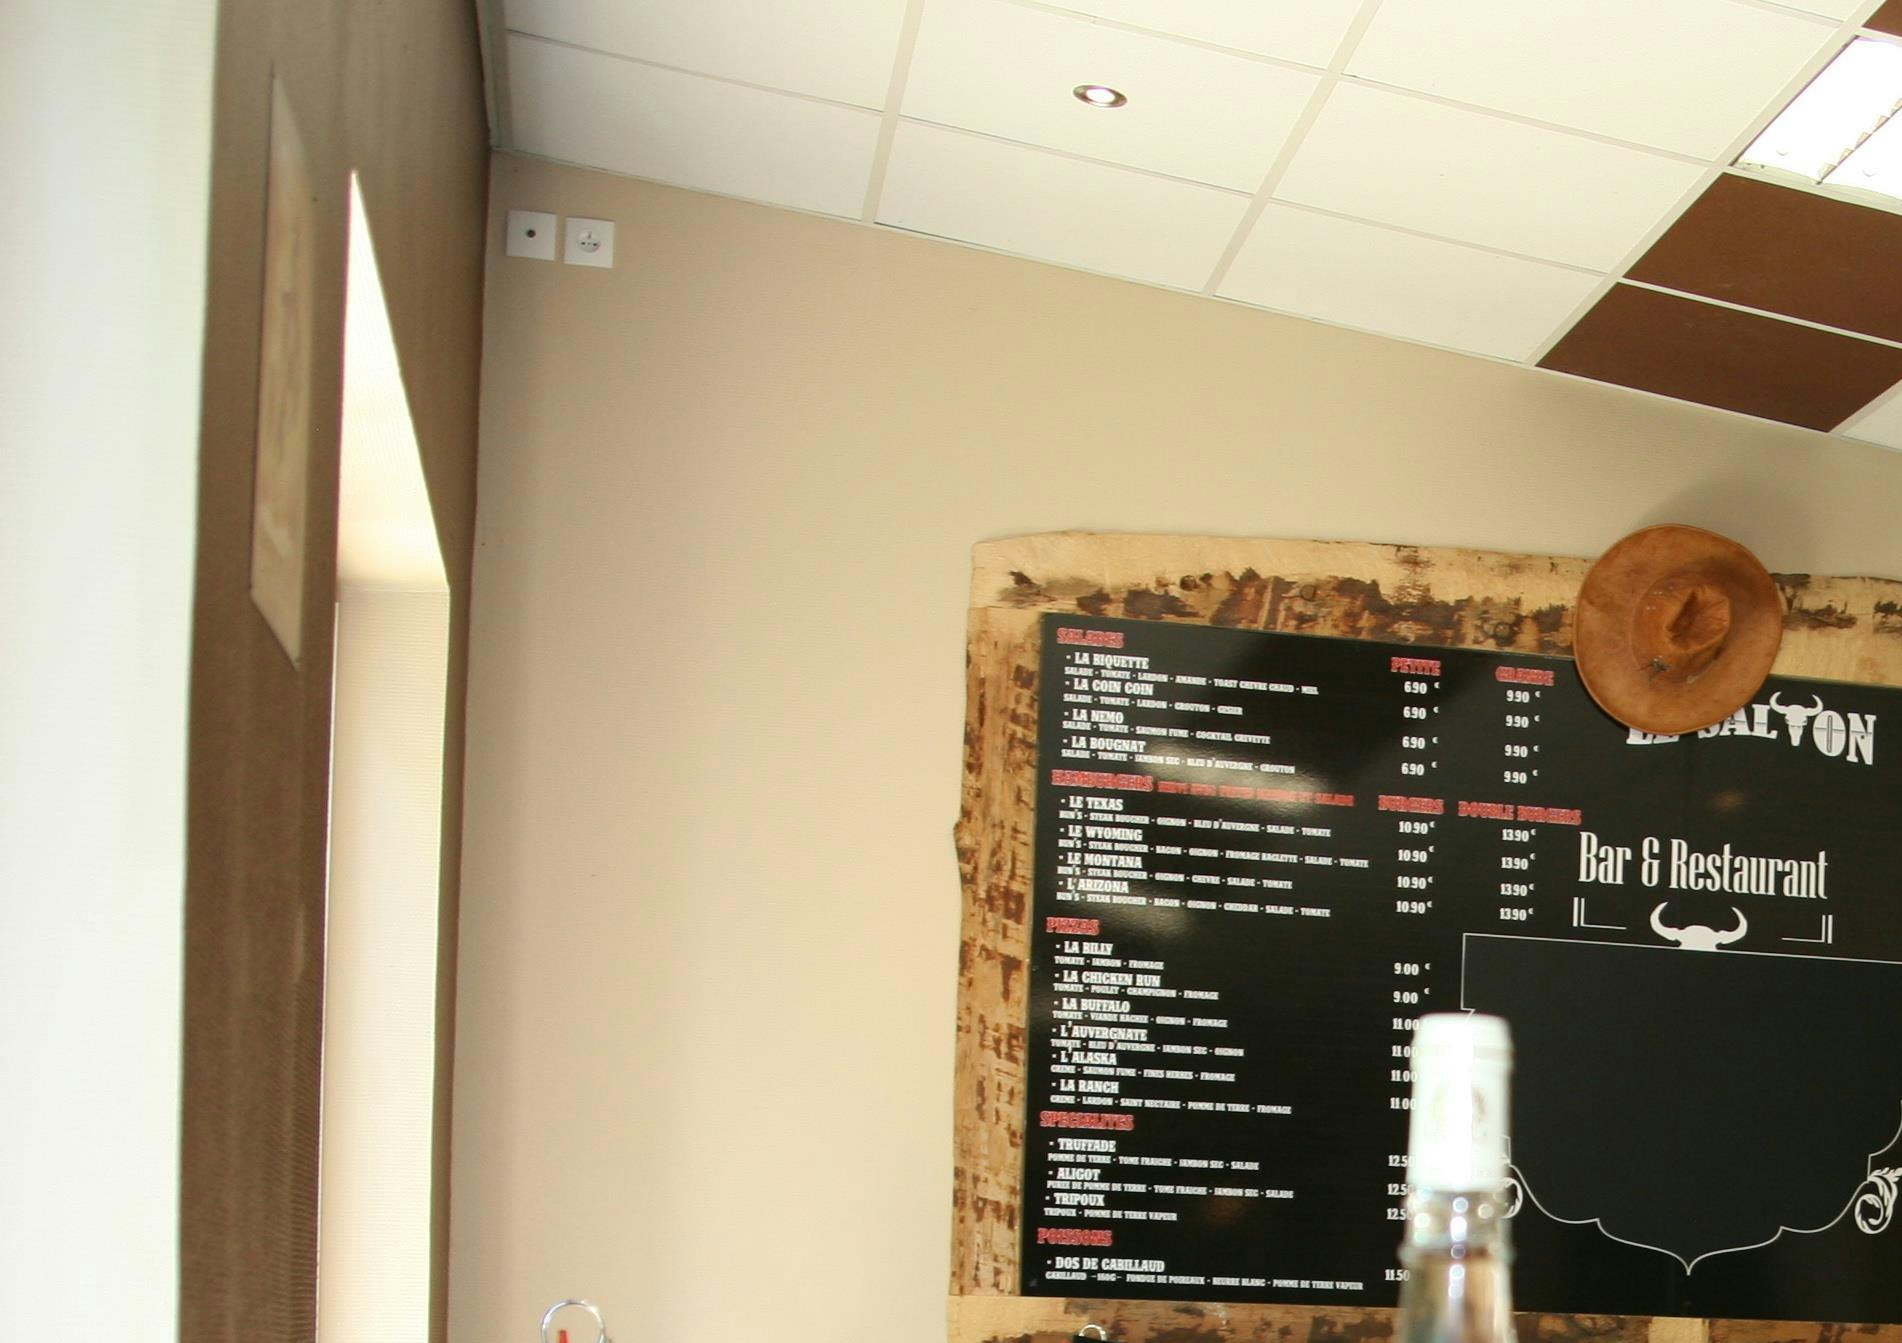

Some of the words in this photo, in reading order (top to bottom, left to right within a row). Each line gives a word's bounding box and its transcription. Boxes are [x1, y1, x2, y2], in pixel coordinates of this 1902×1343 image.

[1074, 651, 1090, 665] LA
[1092, 653, 1149, 670] BIQUETTE
[1391, 656, 1441, 676] PETITE
[1073, 677, 1089, 691] LA
[1092, 679, 1122, 693] COIN
[1124, 681, 1154, 696] COIN
[1072, 708, 1088, 722] LA
[1071, 735, 1087, 749] LA
[1089, 737, 1146, 753] BOUGNAT
[1069, 795, 1084, 809] LE
[1085, 796, 1124, 811] TEXAS
[1068, 824, 1083, 838] LE
[1084, 825, 1143, 842] WYOMING
[1067, 851, 1082, 865] LE
[1083, 853, 1143, 869] MONTANA
[1578, 831, 1632, 885] Bar
[1641, 836, 1661, 887] &
[1669, 838, 1828, 900] Restaurant
[1064, 940, 1080, 954] LA
[1063, 969, 1079, 983] LA
[1081, 971, 1133, 986] CHICKEN
[1135, 974, 1161, 987] RUN
[1062, 997, 1078, 1010] LA
[1080, 998, 1131, 1013] BUFFALO
[1059, 1078, 1076, 1092] LA
[1078, 1079, 1119, 1094] RANCH
[1057, 1137, 1116, 1153] TRUFFADE
[1056, 1167, 1101, 1181] ALIGOT
[1387, 1183, 1414, 1196] 12.5
[1053, 1192, 1105, 1206] TRIPOUX
[1055, 1256, 1080, 1270] DOS
[1082, 1257, 1099, 1270] DE
[1101, 1258, 1165, 1273] CABILLAUD
